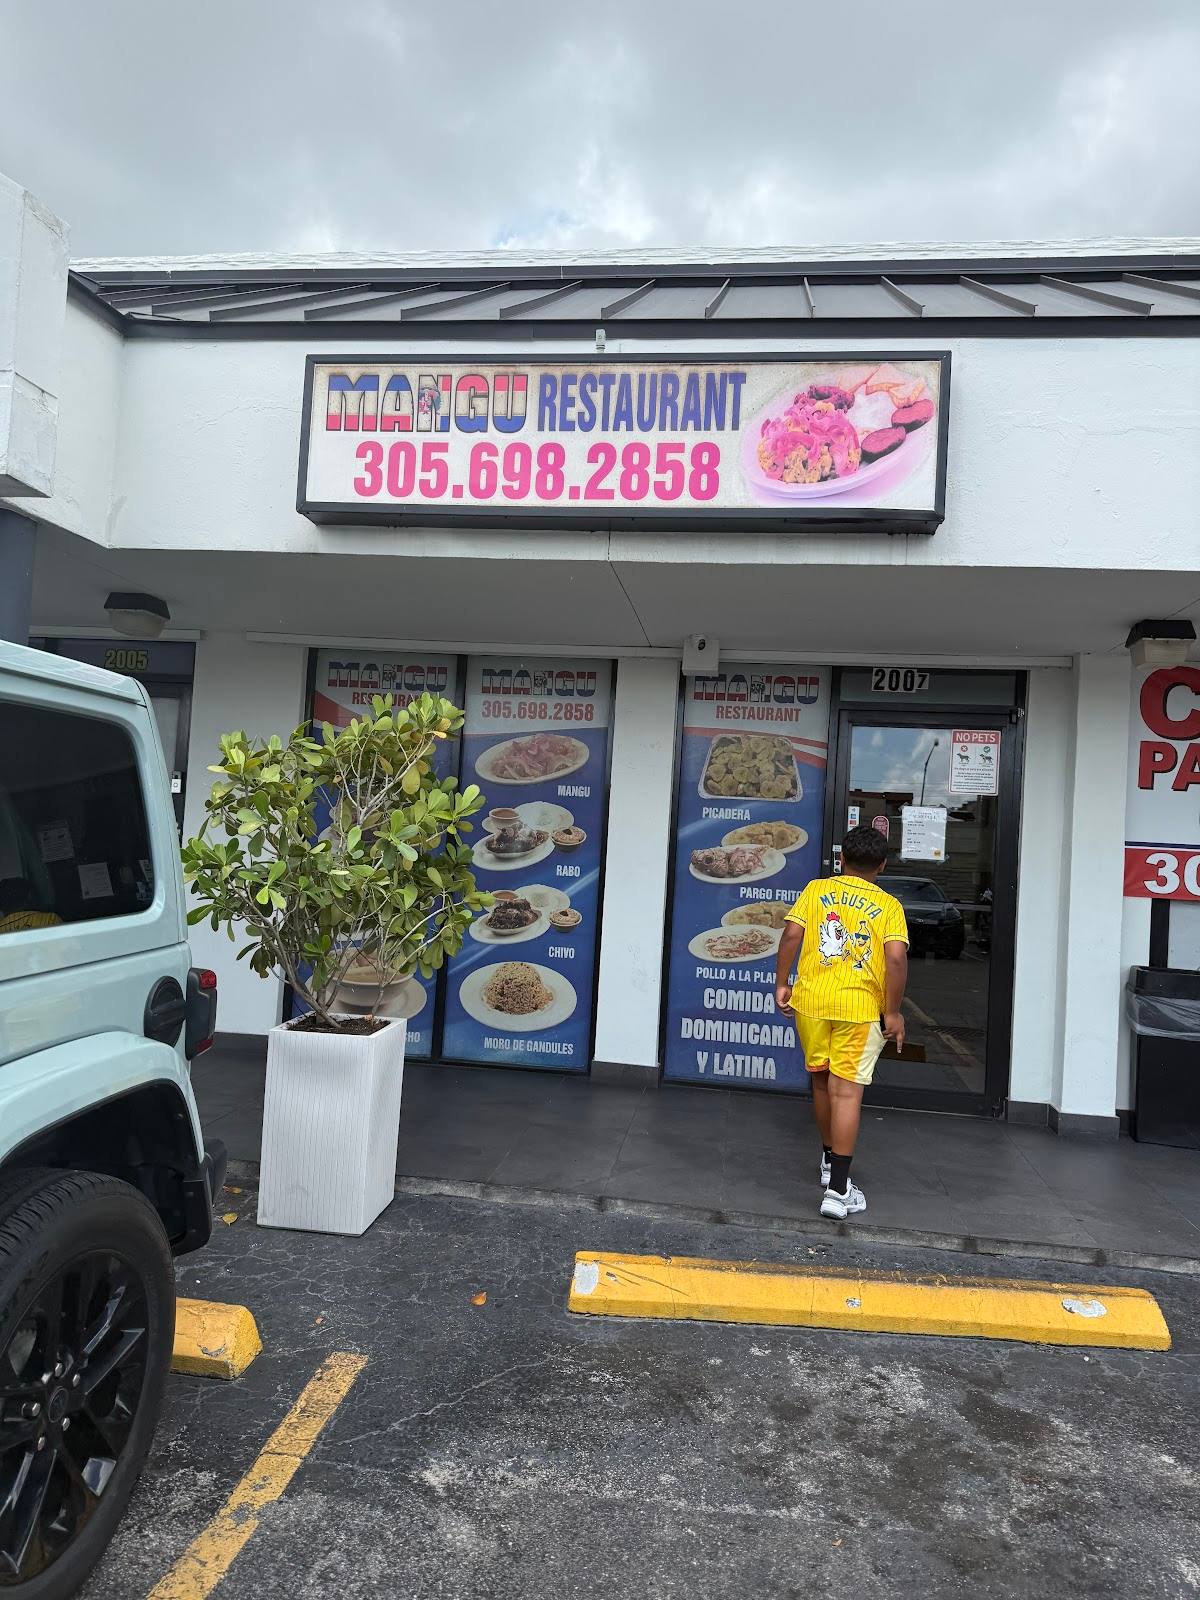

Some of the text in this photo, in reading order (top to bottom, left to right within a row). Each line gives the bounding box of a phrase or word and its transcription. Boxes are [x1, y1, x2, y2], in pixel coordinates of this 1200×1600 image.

[326, 372, 747, 433] MANGU RESTAURANT
[353, 441, 721, 501] 305.698.2858
[104, 650, 148, 670] 2005
[327, 661, 448, 692] MANGU
[481, 668, 597, 697] MANGU
[873, 669, 928, 691] 2007
[694, 675, 820, 705] MANGU
[481, 700, 594, 721] 305.698.2858
[715, 705, 801, 722] RESTAURANT
[1139, 666, 1200, 741] C
[956, 732, 996, 743] NO PETS
[1138, 740, 1200, 792] PA
[557, 785, 591, 798] MANGU
[702, 806, 751, 821] PICADERA
[556, 865, 581, 878] RABO
[740, 886, 773, 900] PARGO
[820, 891, 883, 920] ME GUSTA
[548, 946, 575, 959] CHIVO
[696, 966, 799, 986] POLLO A LA PLAH
[703, 987, 776, 1014] COMIDA
[680, 1017, 796, 1049] DOMINICANA
[484, 1037, 574, 1055] MORO DE GANDULES
[696, 1051, 777, 1080] Y LATINA
